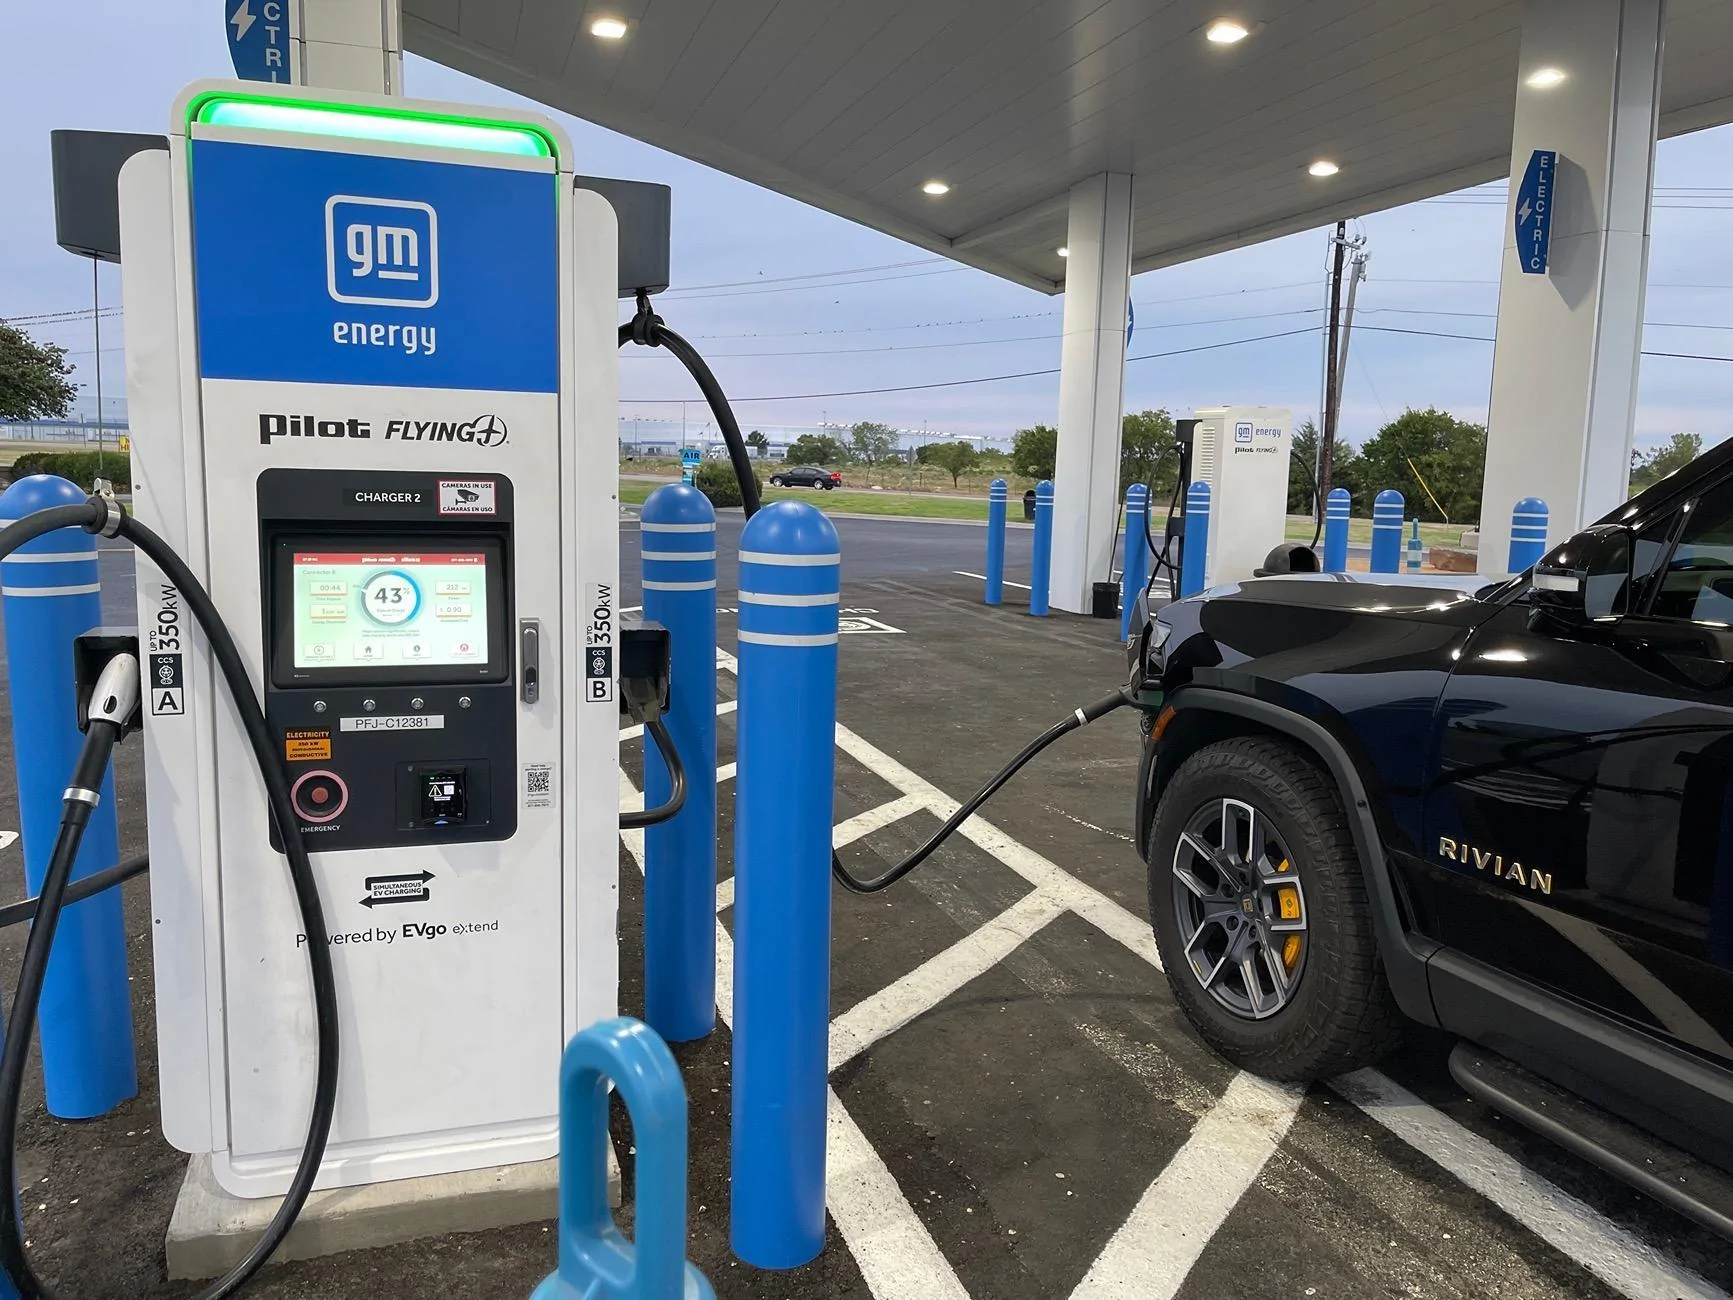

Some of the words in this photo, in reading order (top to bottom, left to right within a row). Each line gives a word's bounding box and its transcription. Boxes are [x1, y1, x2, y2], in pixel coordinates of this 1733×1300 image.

[1531, 155, 1549, 269] ELECTRIC
[346, 223, 419, 280] gm
[333, 321, 436, 355] energy
[384, 420, 476, 442] FLYING
[1255, 428, 1281, 438] energy
[355, 492, 411, 503] CHARGER
[414, 493, 421, 503] 2
[157, 585, 180, 650] 350kW
[593, 584, 611, 644] 350kW
[149, 630, 157, 640] TO
[586, 625, 593, 635] TO
[586, 635, 593, 645] UP
[150, 641, 158, 651] UP
[593, 680, 607, 698] B
[157, 691, 179, 711] A
[355, 718, 428, 729] PFJ-C12381
[286, 731, 330, 739] ELECTRICITY
[300, 825, 340, 833] EMERGENCY
[1439, 836, 1552, 895] RIVIAN
[373, 882, 422, 890] SIMULTANEOUS
[384, 888, 422, 896] CHARGING
[296, 928, 372, 948] Pered
[376, 928, 397, 944] by
[402, 923, 447, 939] EVgo
